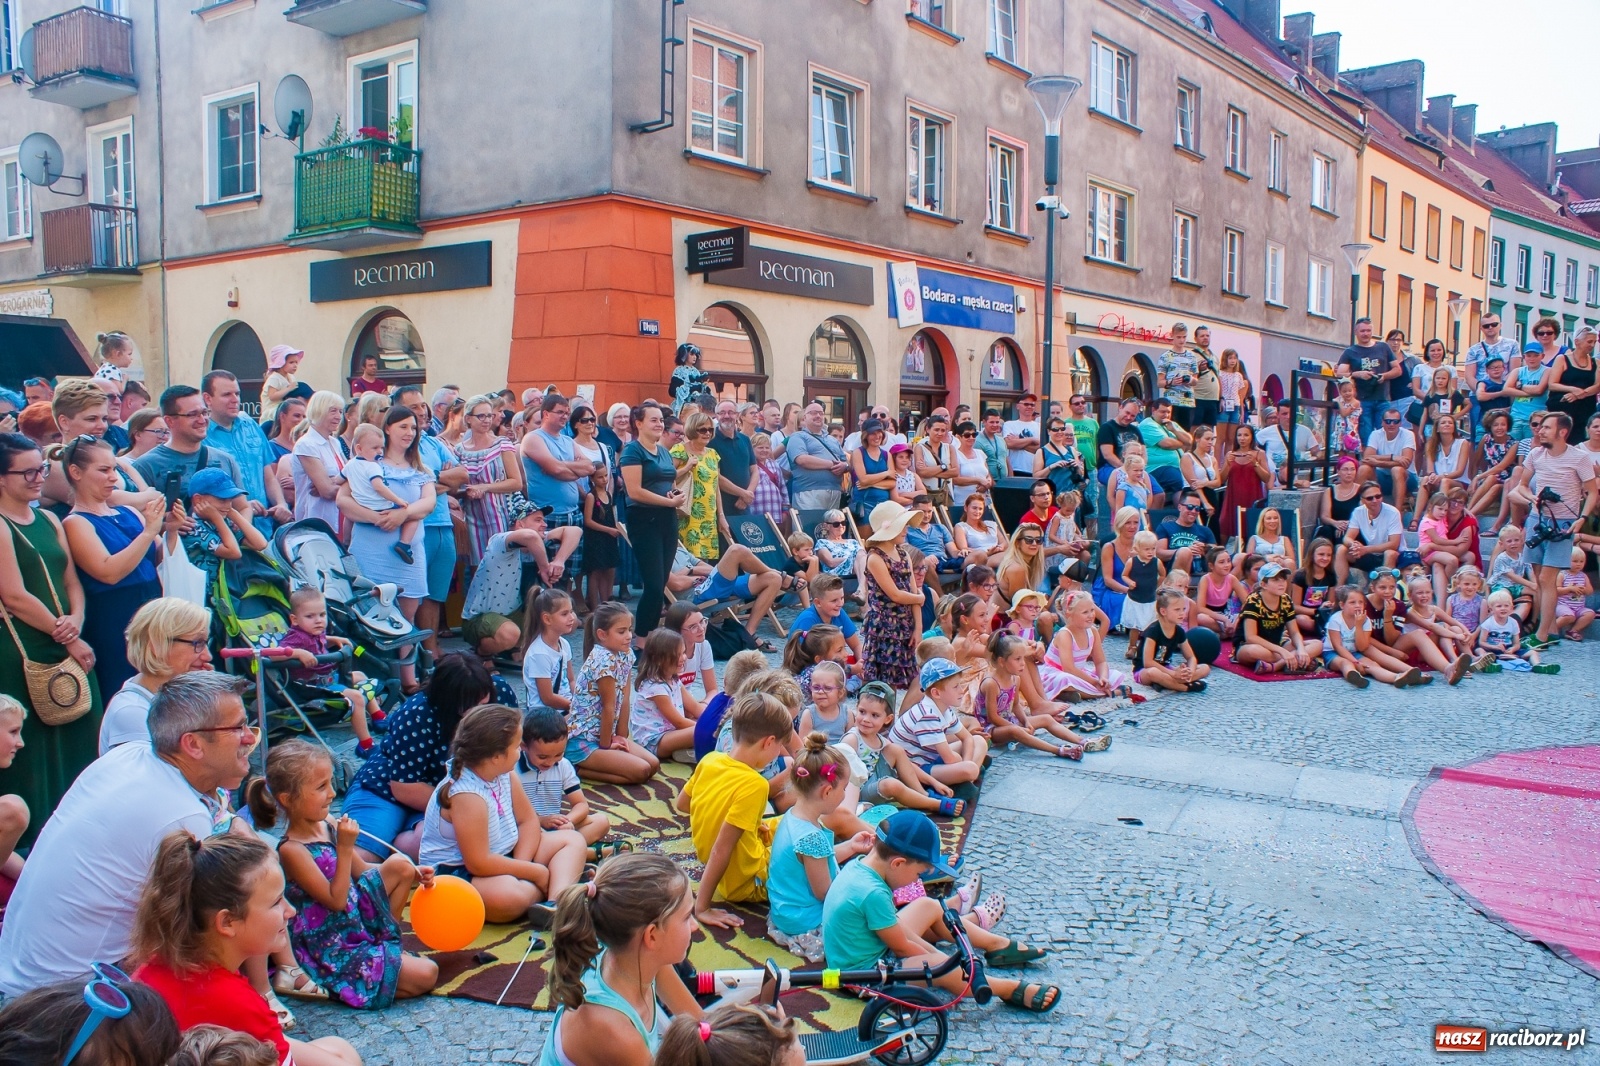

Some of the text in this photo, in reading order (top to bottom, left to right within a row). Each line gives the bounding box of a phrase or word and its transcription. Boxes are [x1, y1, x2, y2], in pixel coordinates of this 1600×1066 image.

[922, 285, 956, 304] Bodara
[962, 295, 991, 311] męska
[992, 300, 1014, 314] rzecz
